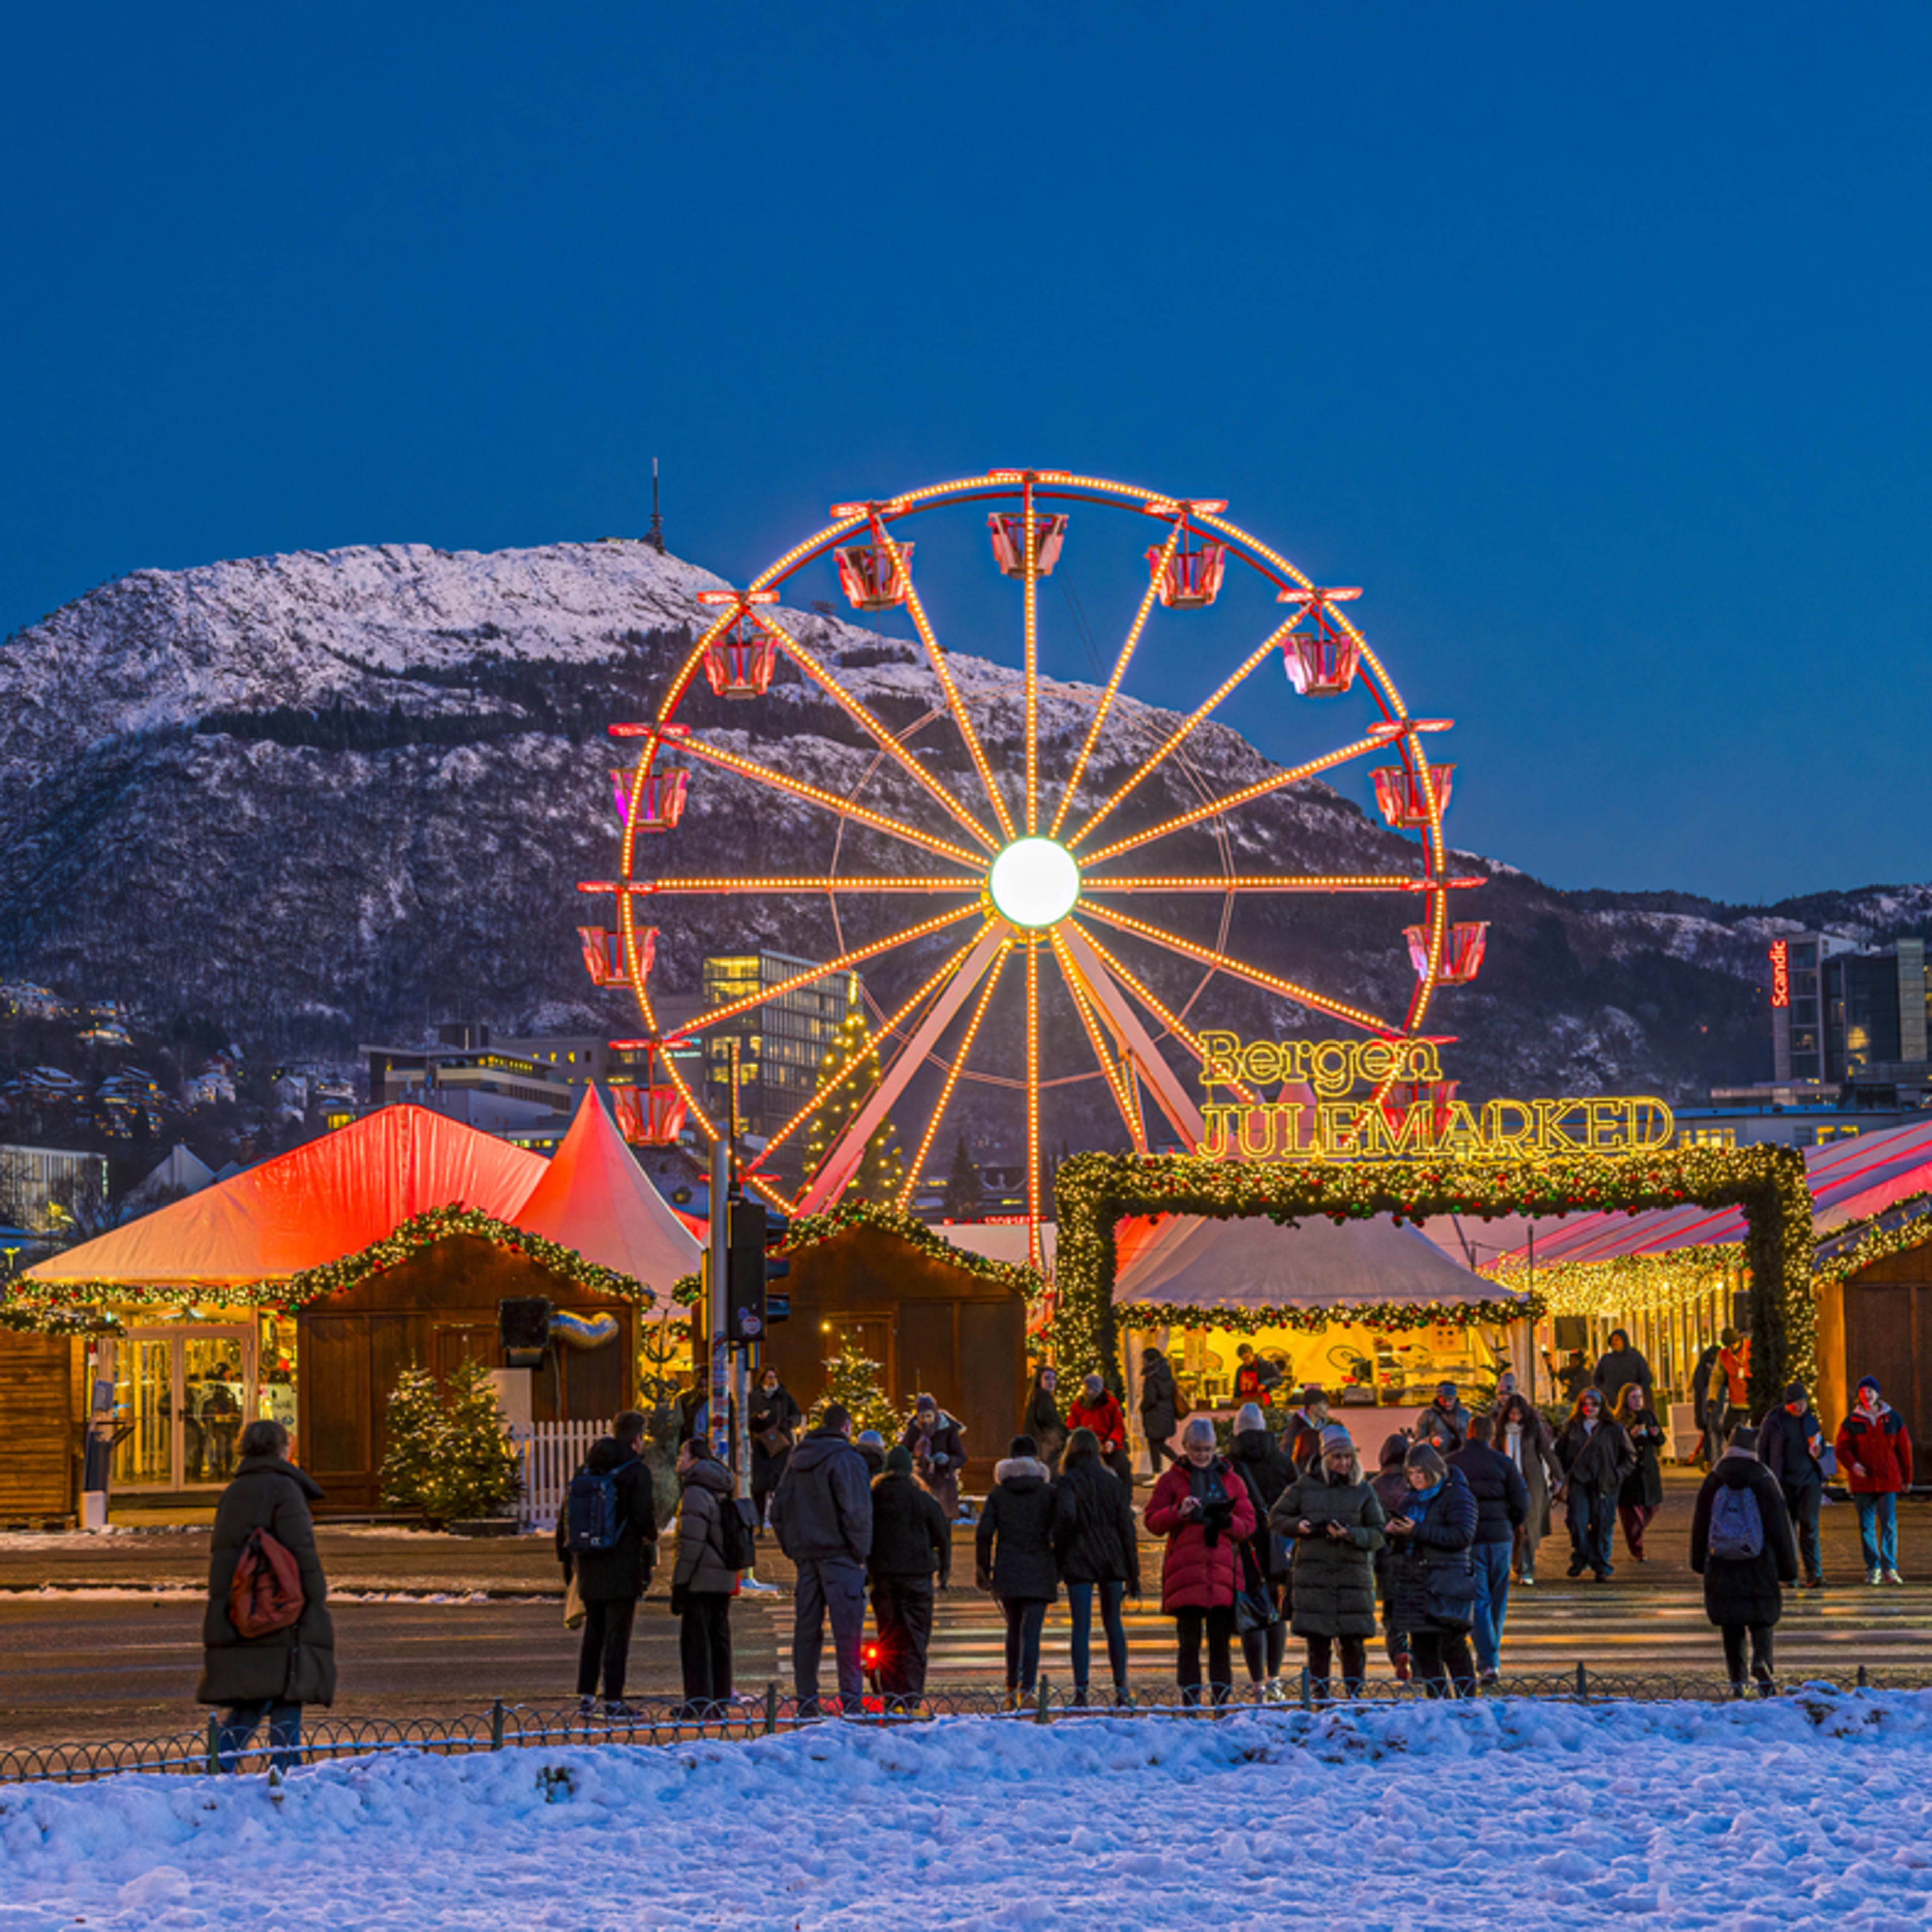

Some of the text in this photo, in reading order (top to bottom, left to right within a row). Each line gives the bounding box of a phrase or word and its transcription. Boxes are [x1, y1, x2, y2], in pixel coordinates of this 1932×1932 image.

[1769, 939, 1788, 1007] Scandic
[1198, 1030, 1443, 1097] Bergen
[1196, 1096, 1674, 1160] JULEMARKED
